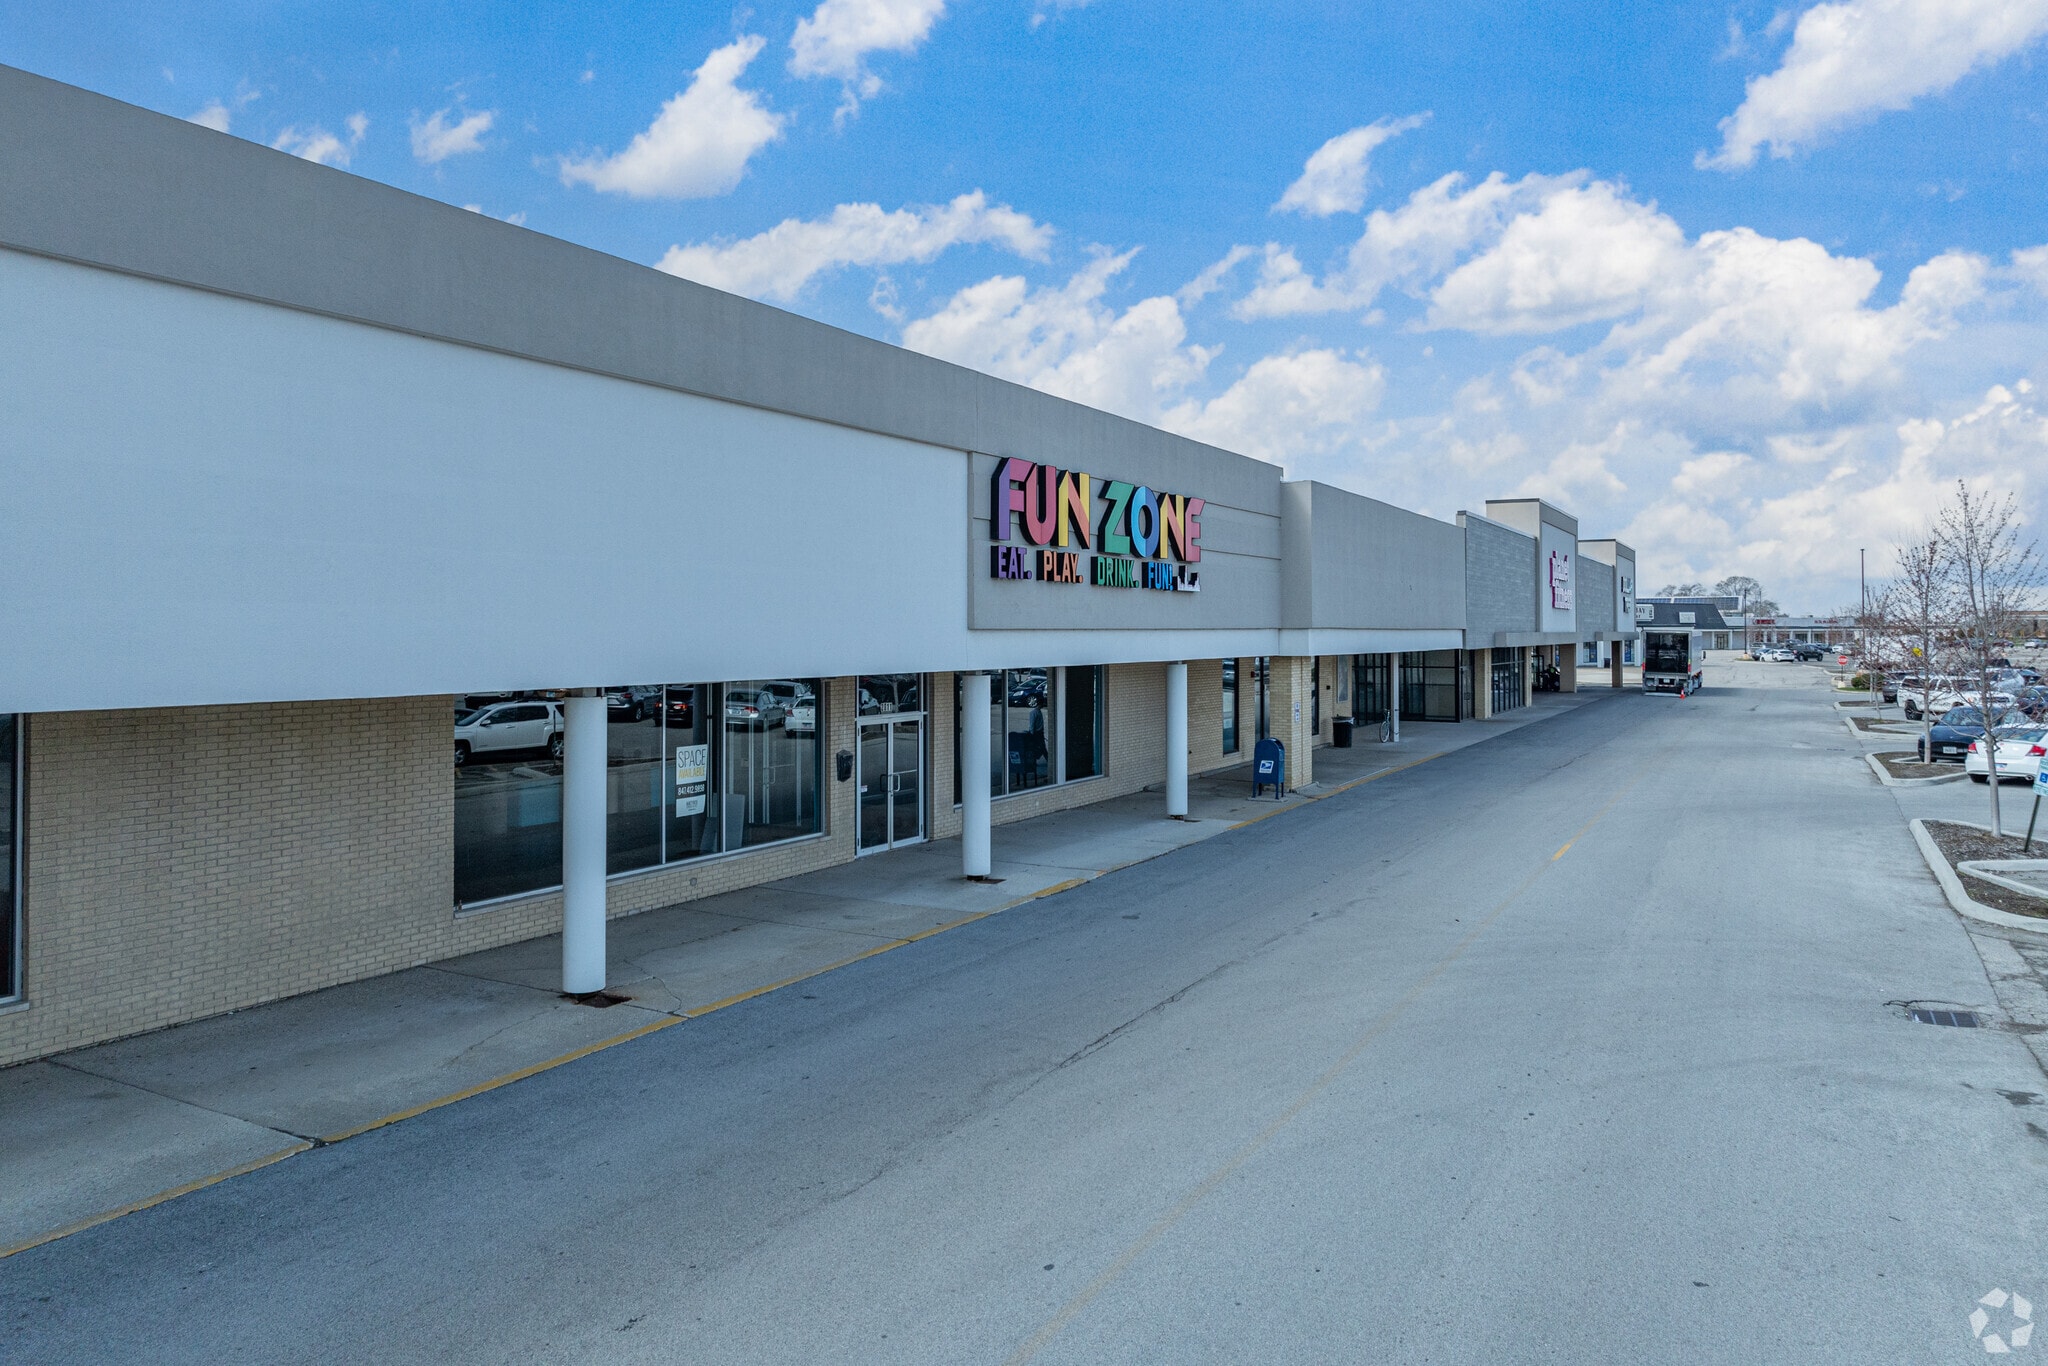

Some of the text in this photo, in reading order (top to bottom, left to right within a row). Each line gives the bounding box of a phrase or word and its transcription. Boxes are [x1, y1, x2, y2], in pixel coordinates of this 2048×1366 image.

[992, 457, 1206, 562] FUN ZONE
[994, 545, 1174, 592] EAT. PLAY. DRINK. FUN!
[678, 749, 706, 768] SPACE
[678, 767, 705, 779] AVAILABLE
